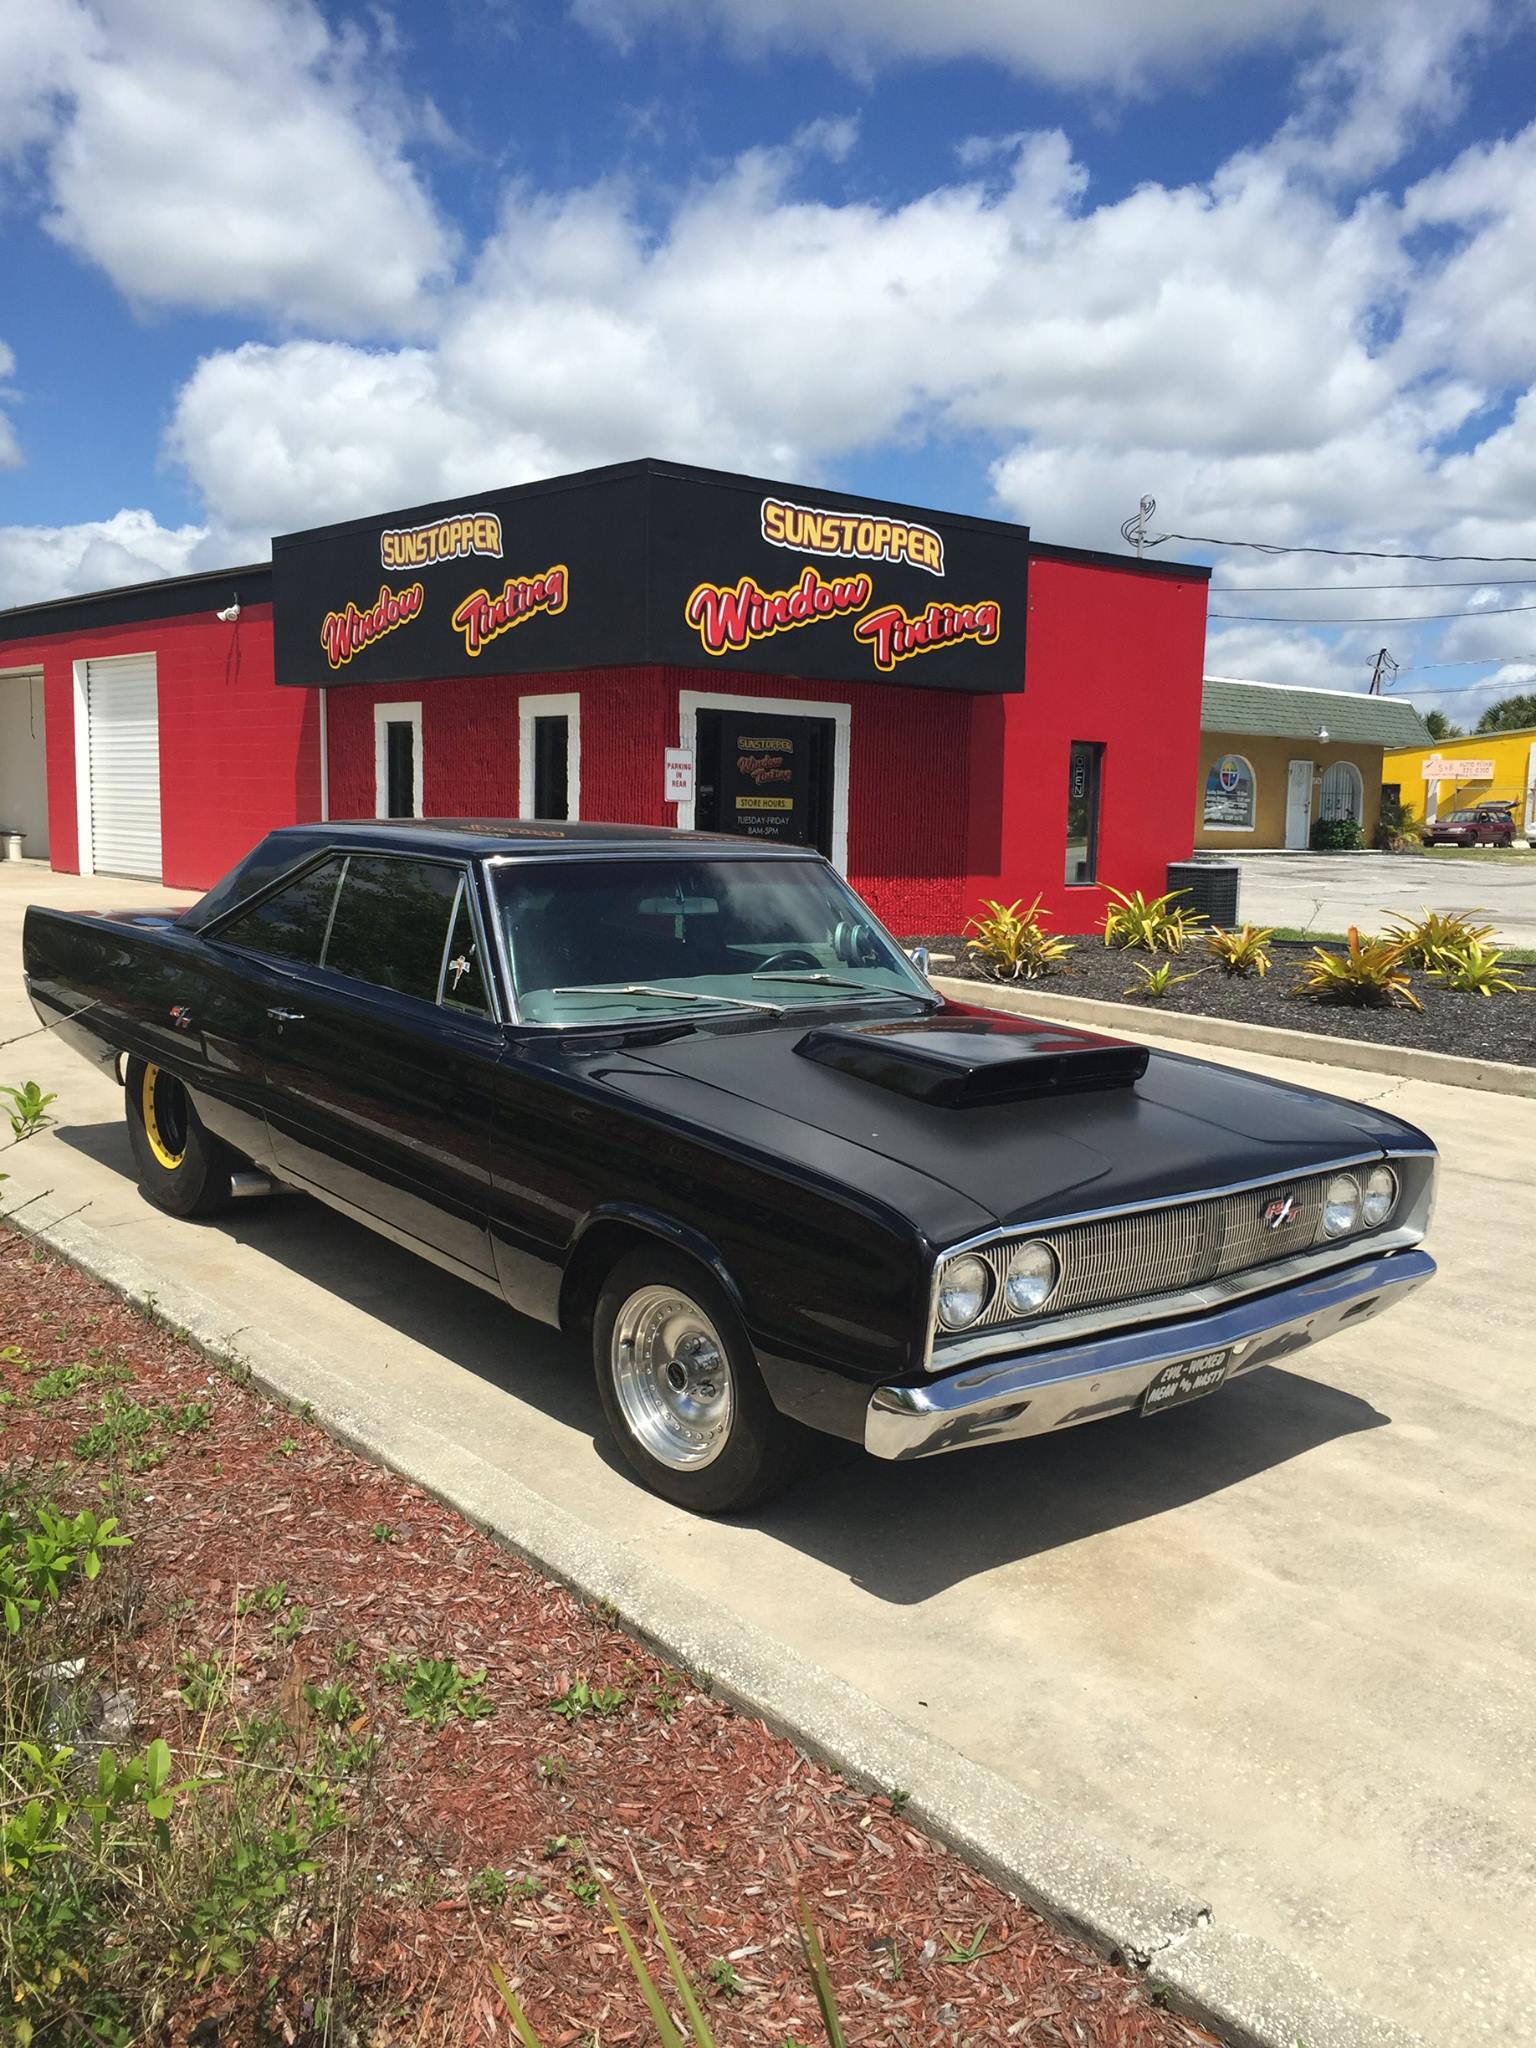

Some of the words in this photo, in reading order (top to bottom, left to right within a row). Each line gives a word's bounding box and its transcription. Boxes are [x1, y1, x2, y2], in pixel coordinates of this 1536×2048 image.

[382, 514, 503, 568] SUNSTOPPER
[763, 499, 944, 575] SUNSTOPPER
[322, 584, 423, 667] Window
[453, 567, 566, 653] Tinting
[687, 569, 870, 651] Window
[855, 602, 999, 668] Tinting
[667, 762, 692, 770] PARKING
[672, 780, 687, 788] REAR
[741, 799, 761, 808] STORE
[763, 799, 785, 808] HOURS
[1147, 1382, 1179, 1404] MEAN
[1192, 1367, 1226, 1389] NASTY
[1160, 1364, 1184, 1383] EVIL
[1188, 1351, 1226, 1374] WICKED
